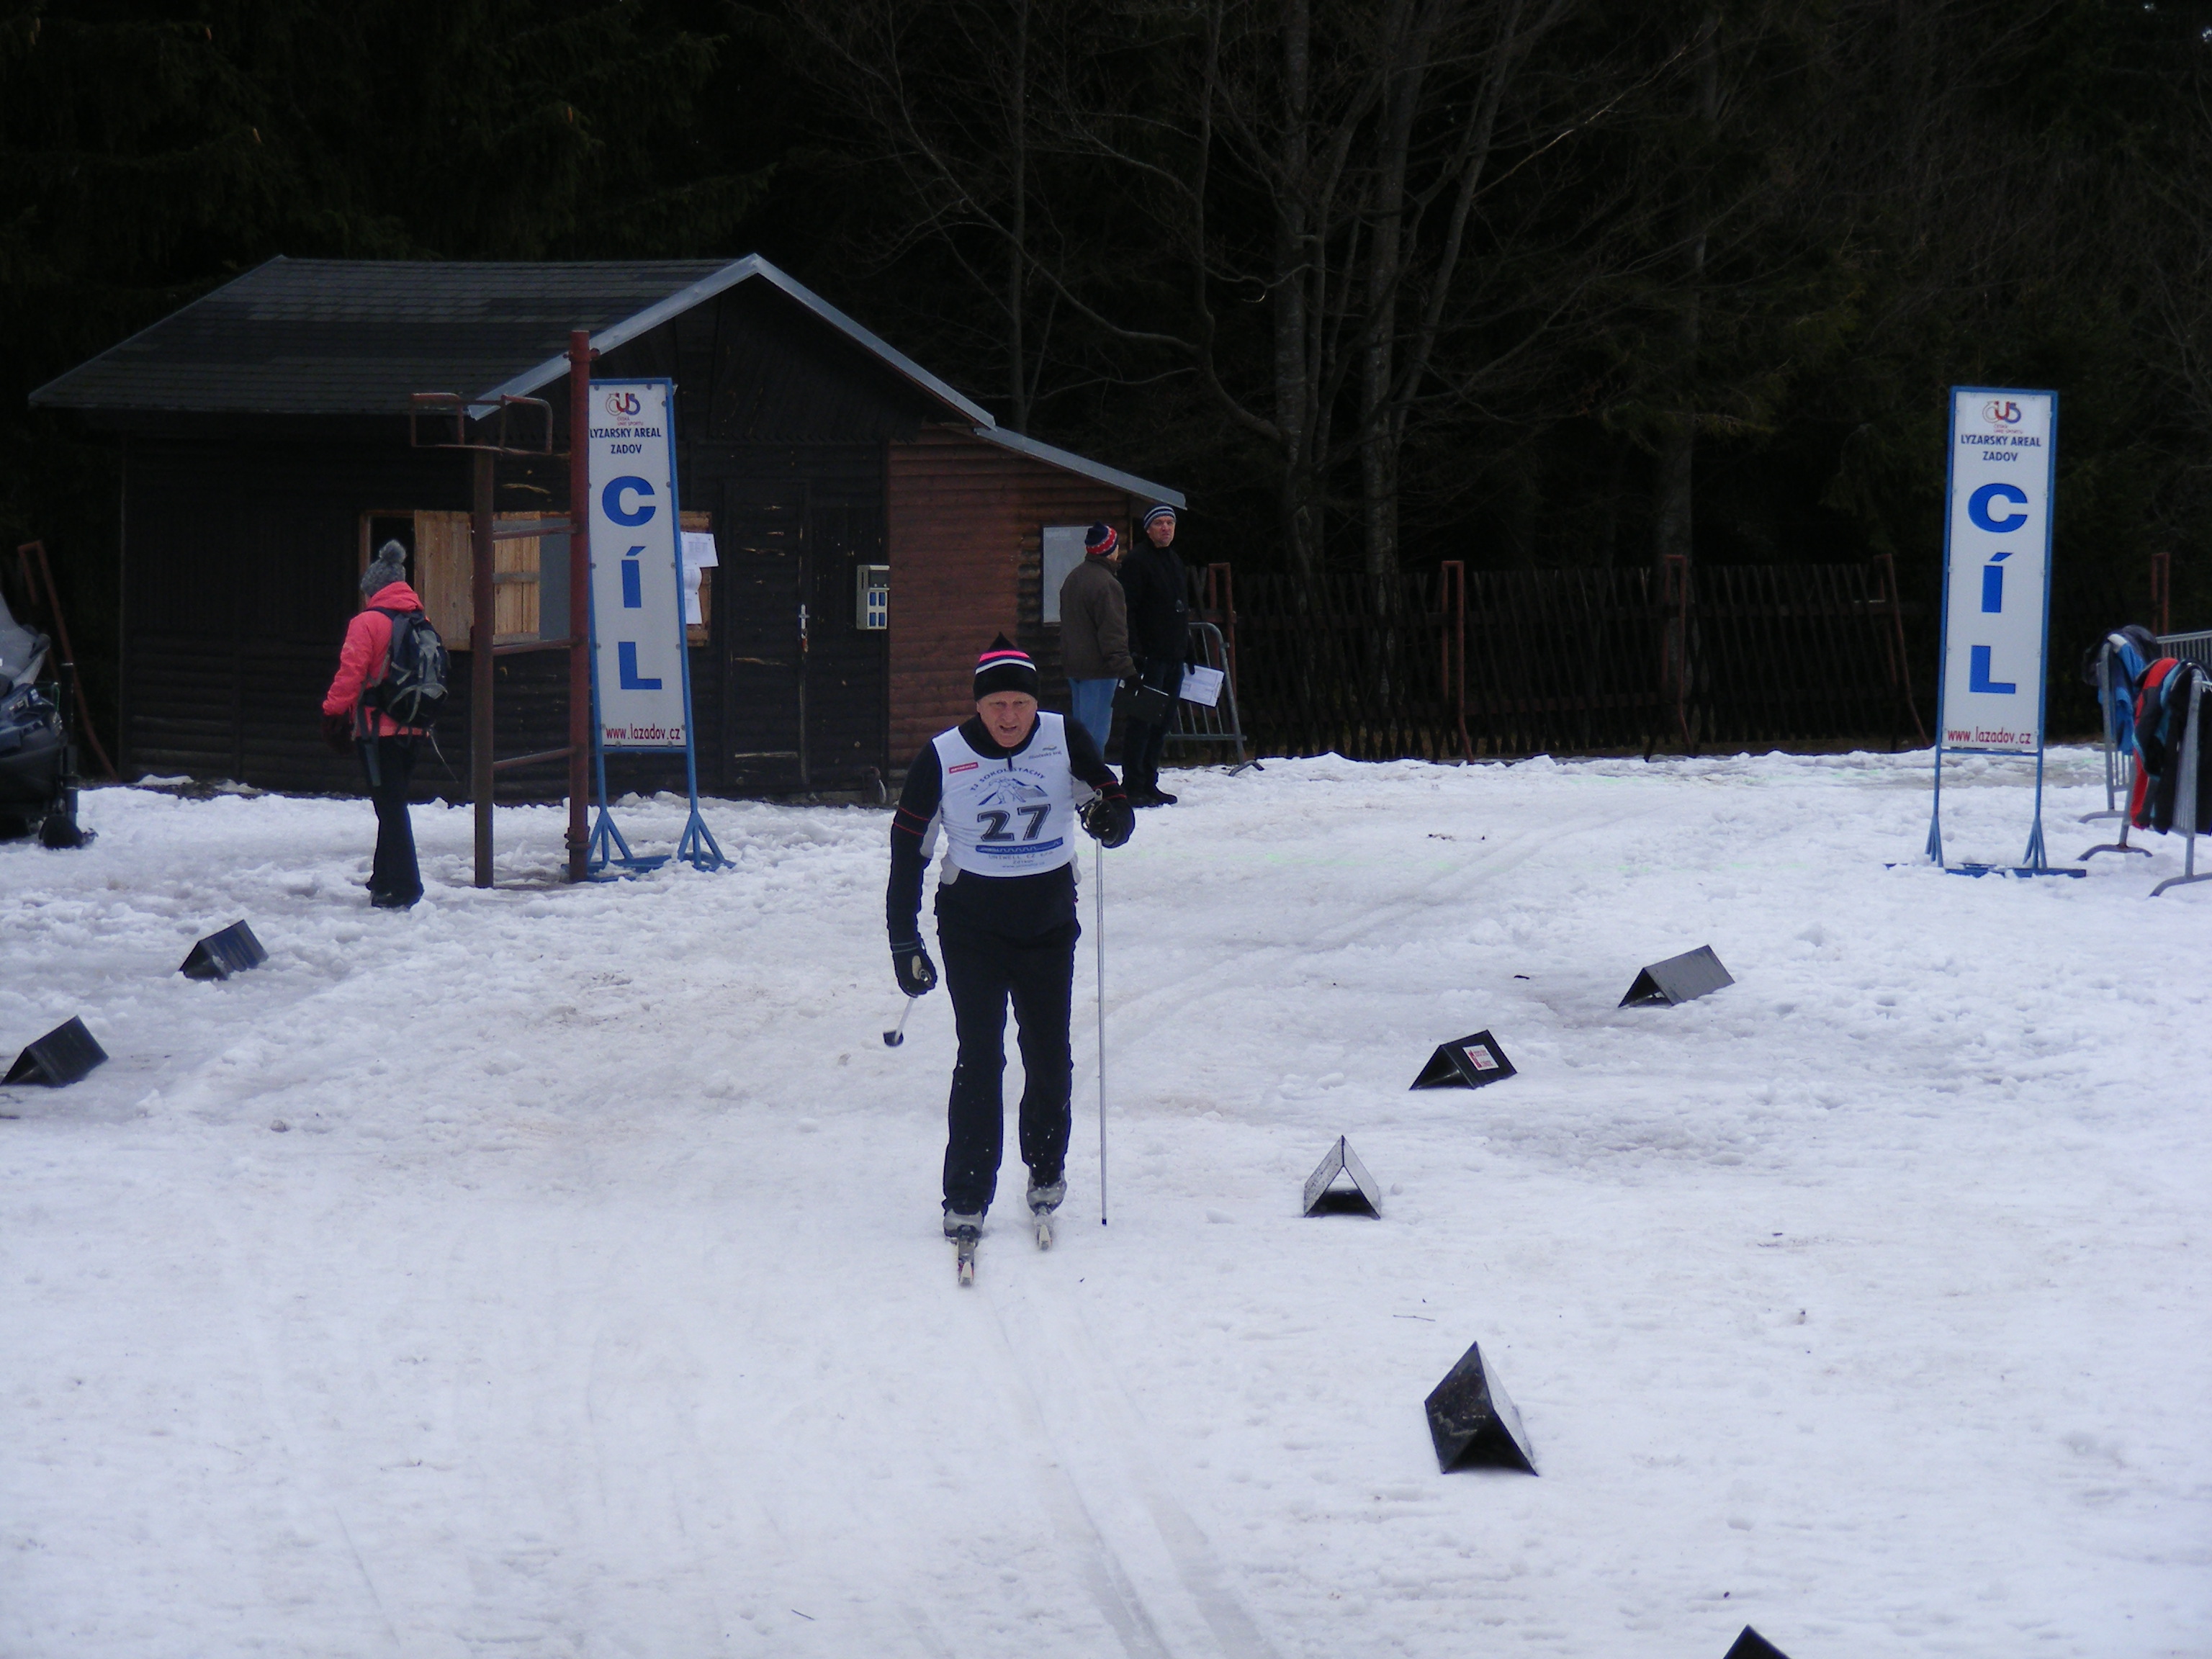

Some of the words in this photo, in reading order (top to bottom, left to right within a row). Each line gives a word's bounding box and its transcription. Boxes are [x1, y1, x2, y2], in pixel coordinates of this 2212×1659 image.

[634, 427, 662, 438] AREAL
[1960, 433, 2008, 446] LYZARSKY
[2010, 436, 2042, 447] AREAL
[611, 444, 642, 454] ZADOV
[1982, 450, 2019, 462] ZADOV
[606, 723, 681, 740] www.lazadov.cz
[1947, 726, 2032, 745] www.lazadov.cz
[977, 804, 1051, 842] 27
